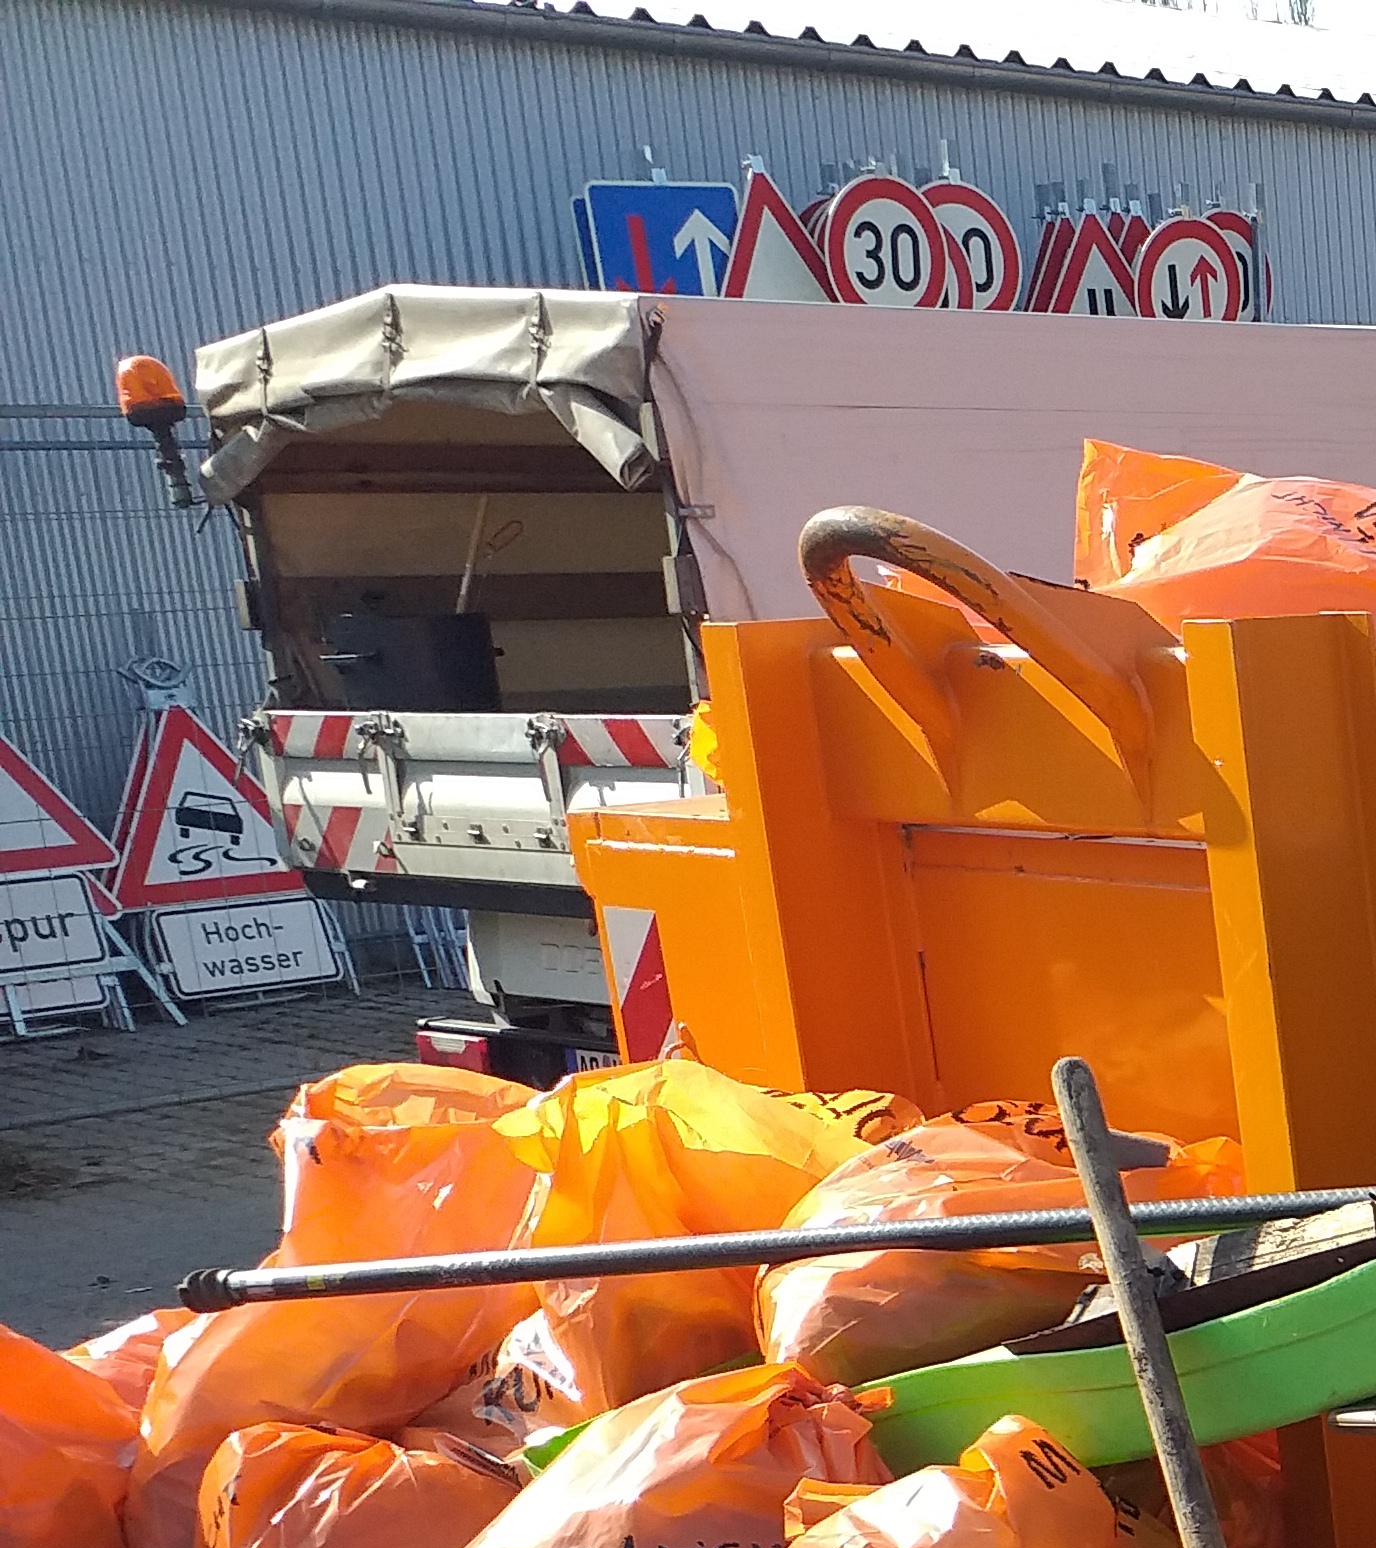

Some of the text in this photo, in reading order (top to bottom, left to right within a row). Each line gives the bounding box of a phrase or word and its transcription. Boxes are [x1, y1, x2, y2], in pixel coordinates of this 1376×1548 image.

[853, 220, 921, 292] 30
[961, 227, 995, 293] 0
[0, 912, 75, 953] pur
[201, 917, 284, 945] Hoch-
[202, 949, 304, 978] wasser
